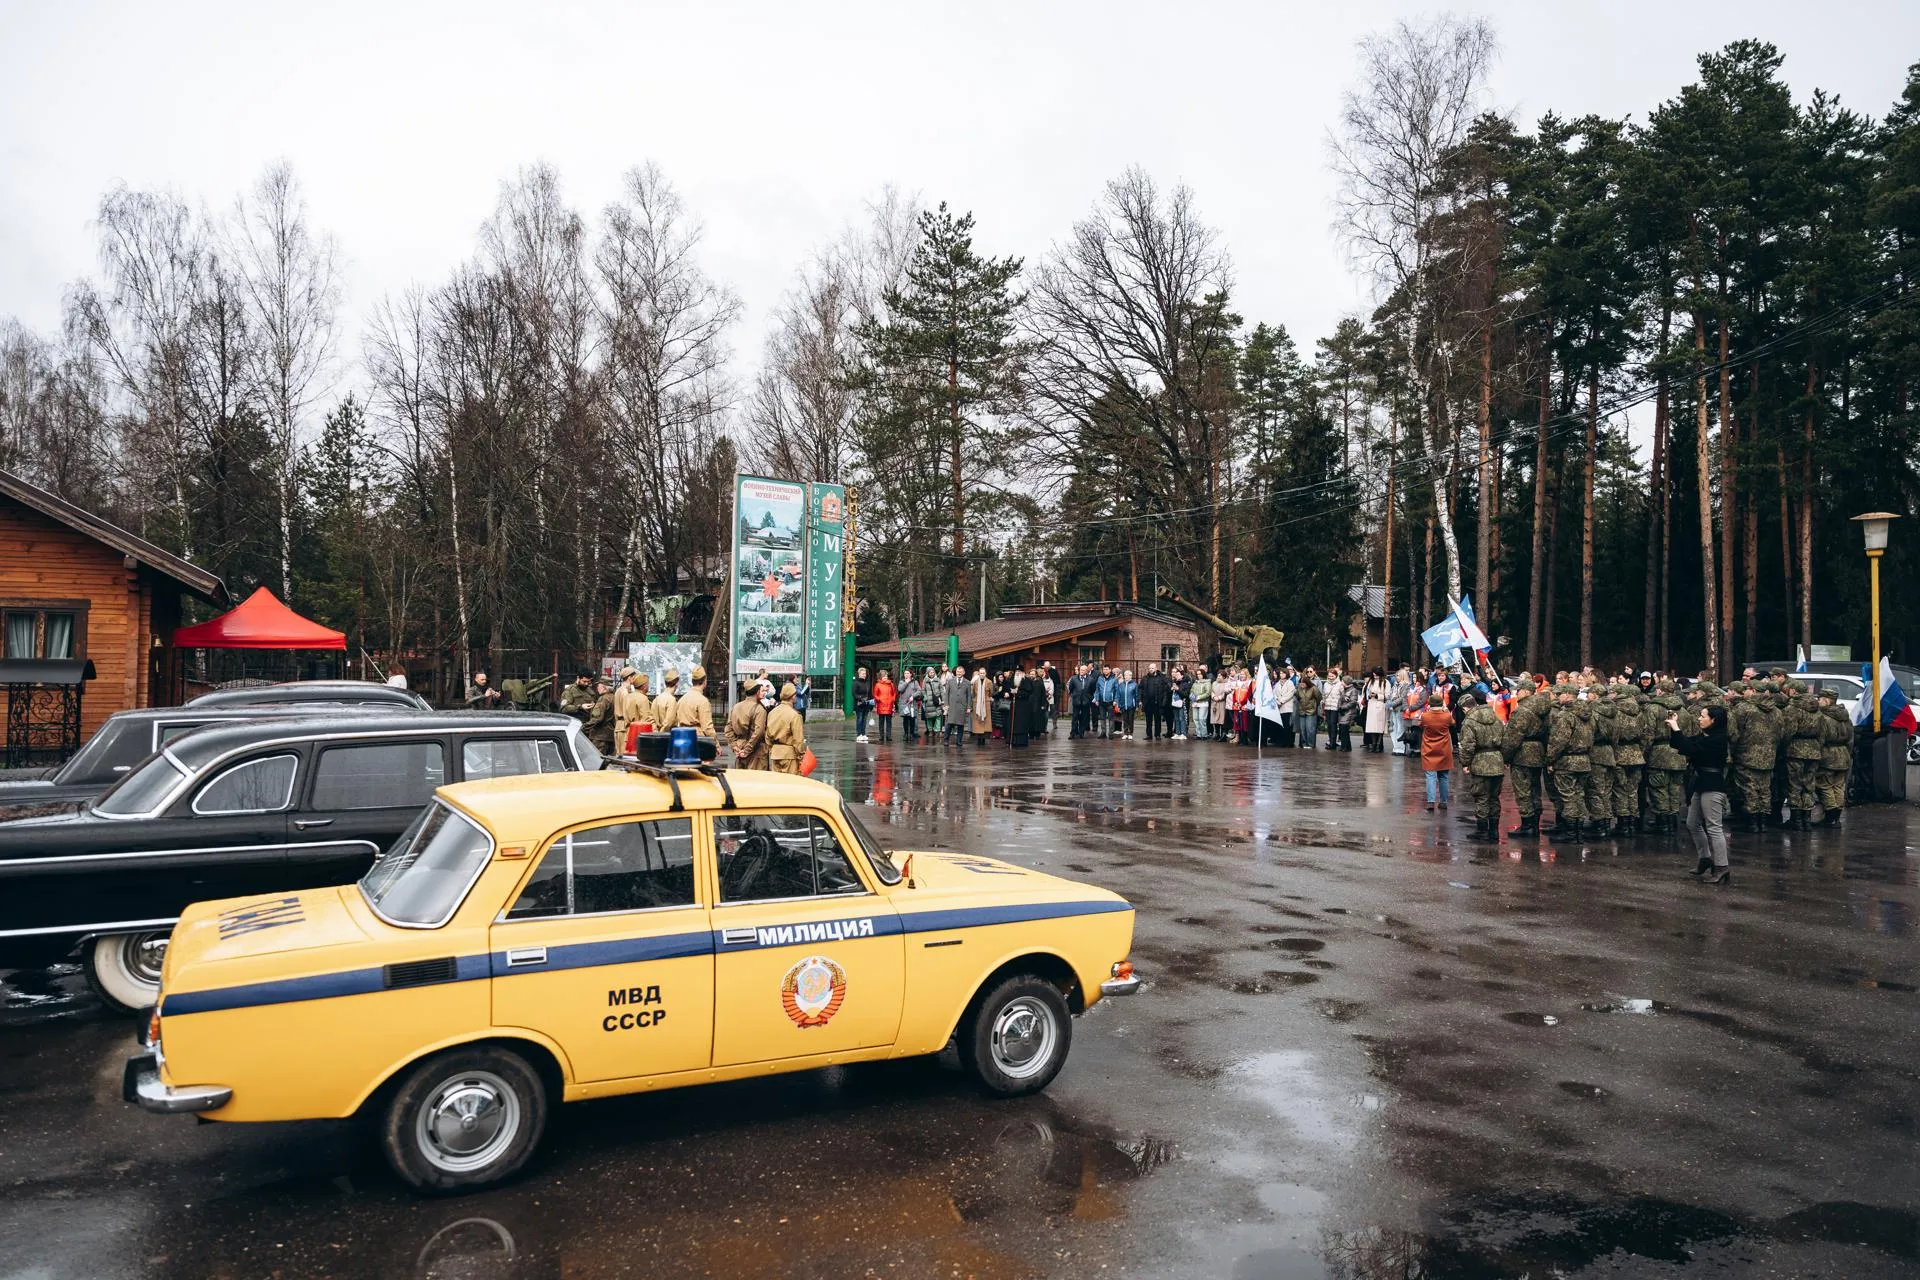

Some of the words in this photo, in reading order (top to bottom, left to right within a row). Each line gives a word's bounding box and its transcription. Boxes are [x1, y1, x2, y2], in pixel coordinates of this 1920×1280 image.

[823, 533, 840, 668] МУЗЕЙ
[758, 919, 874, 945] МИЛИЦИЯ
[608, 985, 661, 1006] МВД
[602, 1009, 667, 1032] СССР
